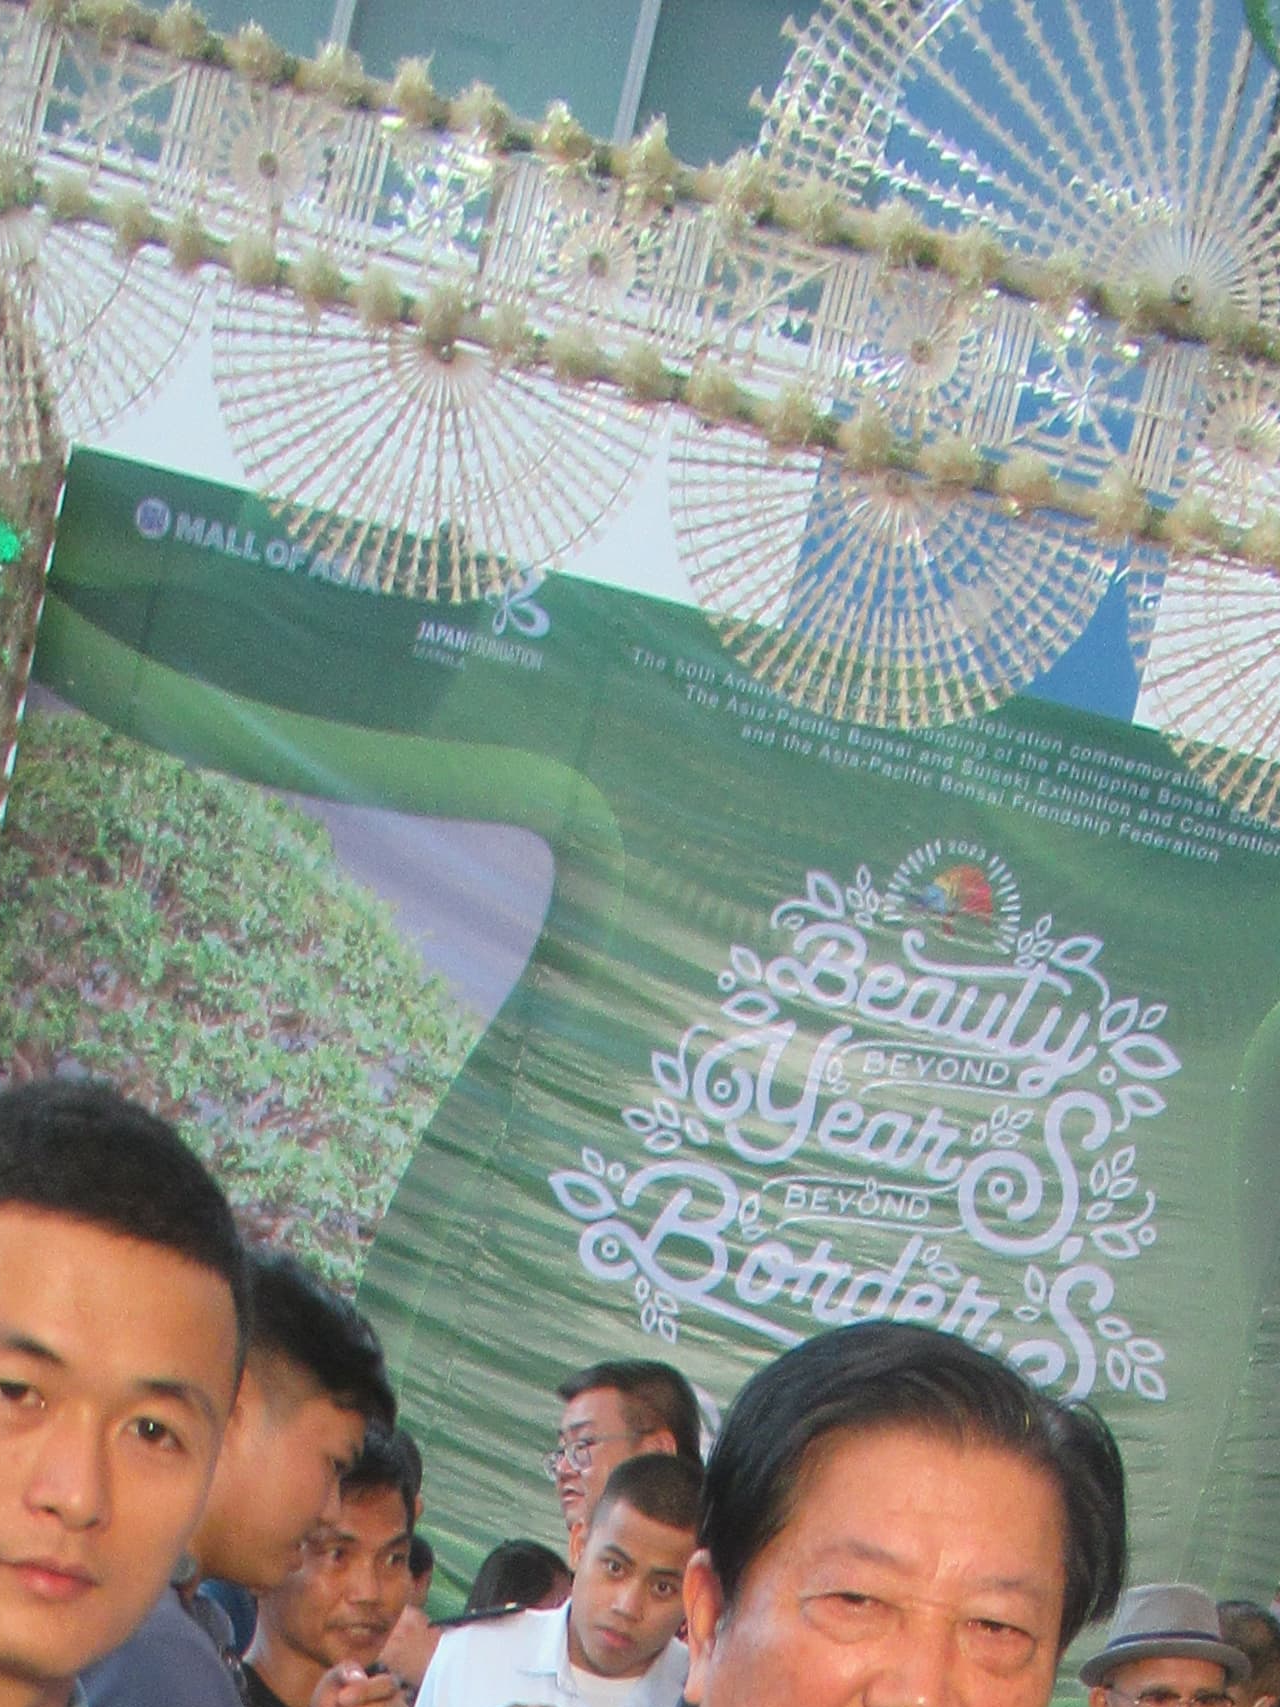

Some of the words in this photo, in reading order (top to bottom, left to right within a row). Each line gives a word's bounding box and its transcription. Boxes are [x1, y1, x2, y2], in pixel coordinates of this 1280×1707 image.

[176, 512, 261, 562] MALL
[632, 647, 666, 671] The
[675, 658, 715, 686] 50th
[993, 746, 1013, 763] of
[1020, 751, 1049, 774] the
[1055, 759, 1151, 801] Philippine
[1157, 787, 1221, 818] Bonsai
[684, 684, 719, 711] The
[725, 693, 841, 742] Asia-Pacific
[847, 727, 913, 760] Bonsai
[920, 750, 954, 771] and
[960, 757, 1032, 792] Suiseki
[1036, 776, 1132, 818] Exhibition
[1138, 807, 1173, 828] and
[740, 724, 776, 747] and
[782, 732, 814, 756] the
[818, 741, 933, 787] Asia-Pacific
[939, 774, 1006, 807] Bonsai
[1011, 793, 1112, 836] Friendship
[1118, 821, 1220, 864] Federation
[947, 839, 987, 862] 2023
[767, 921, 1097, 1099] Beauty
[861, 1050, 1011, 1087] BEYOND
[783, 1178, 932, 1224] BEYOND
